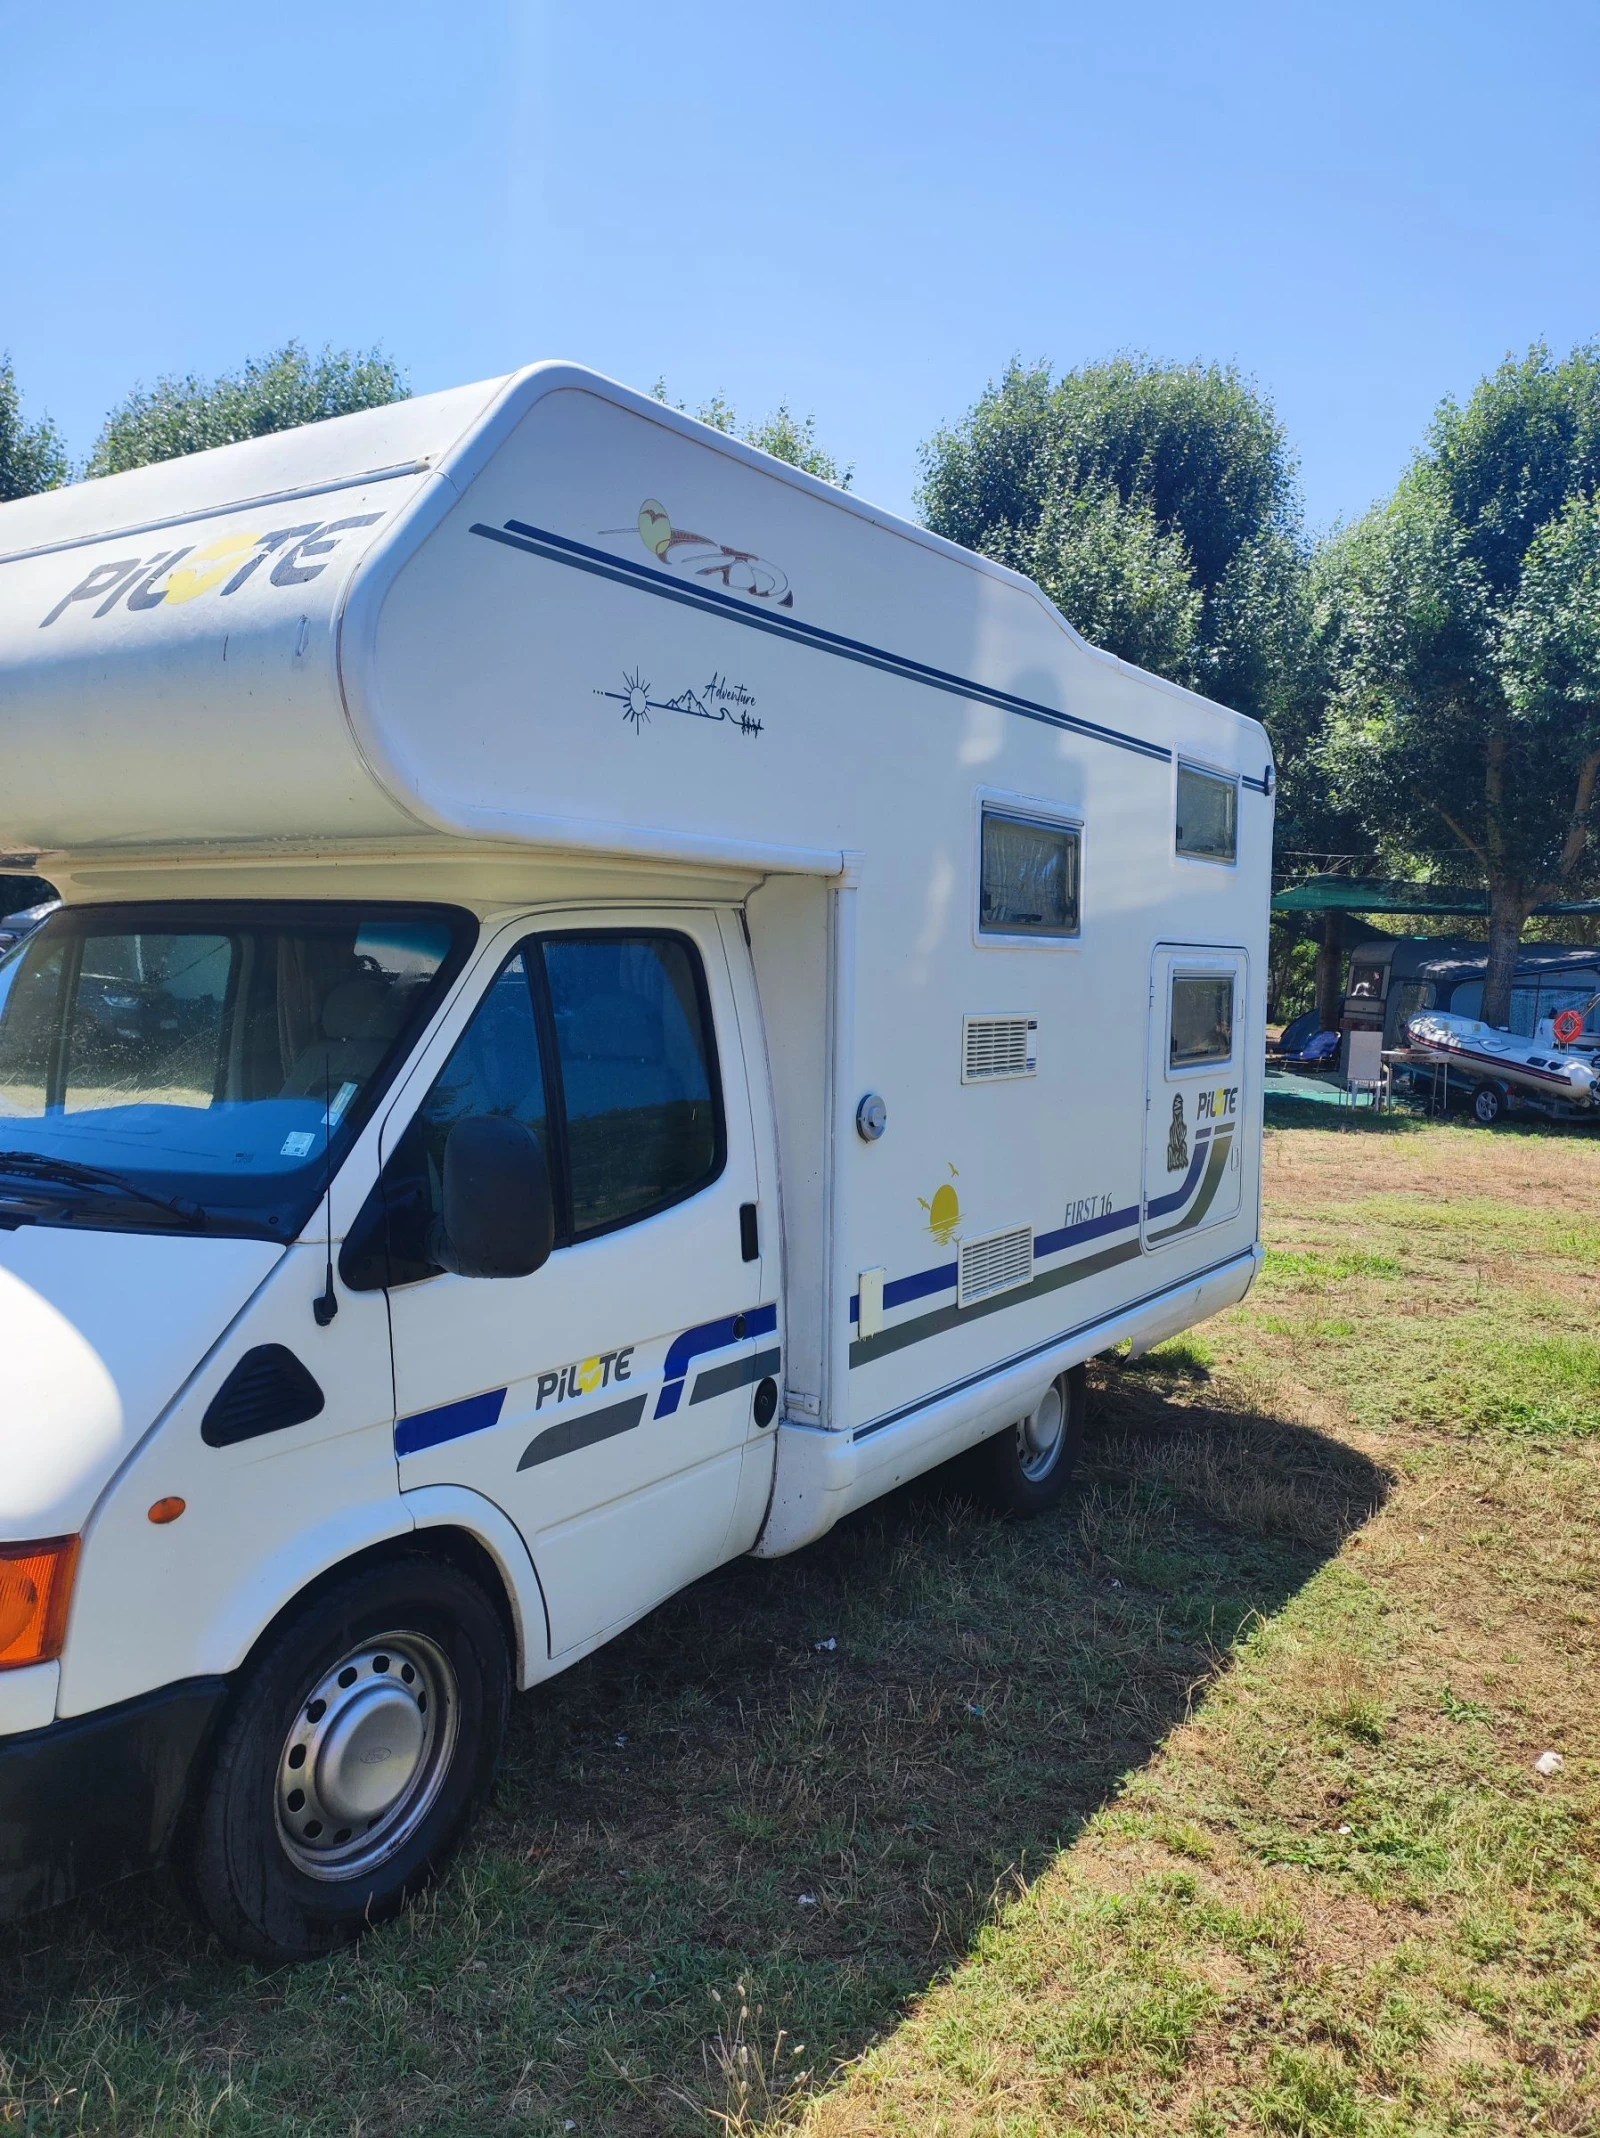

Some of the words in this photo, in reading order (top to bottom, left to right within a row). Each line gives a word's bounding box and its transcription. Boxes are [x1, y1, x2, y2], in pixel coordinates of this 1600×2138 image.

[702, 671, 756, 706] Adventure
[1064, 1195, 1098, 1227] FIRST
[1100, 1191, 1113, 1217] 16
